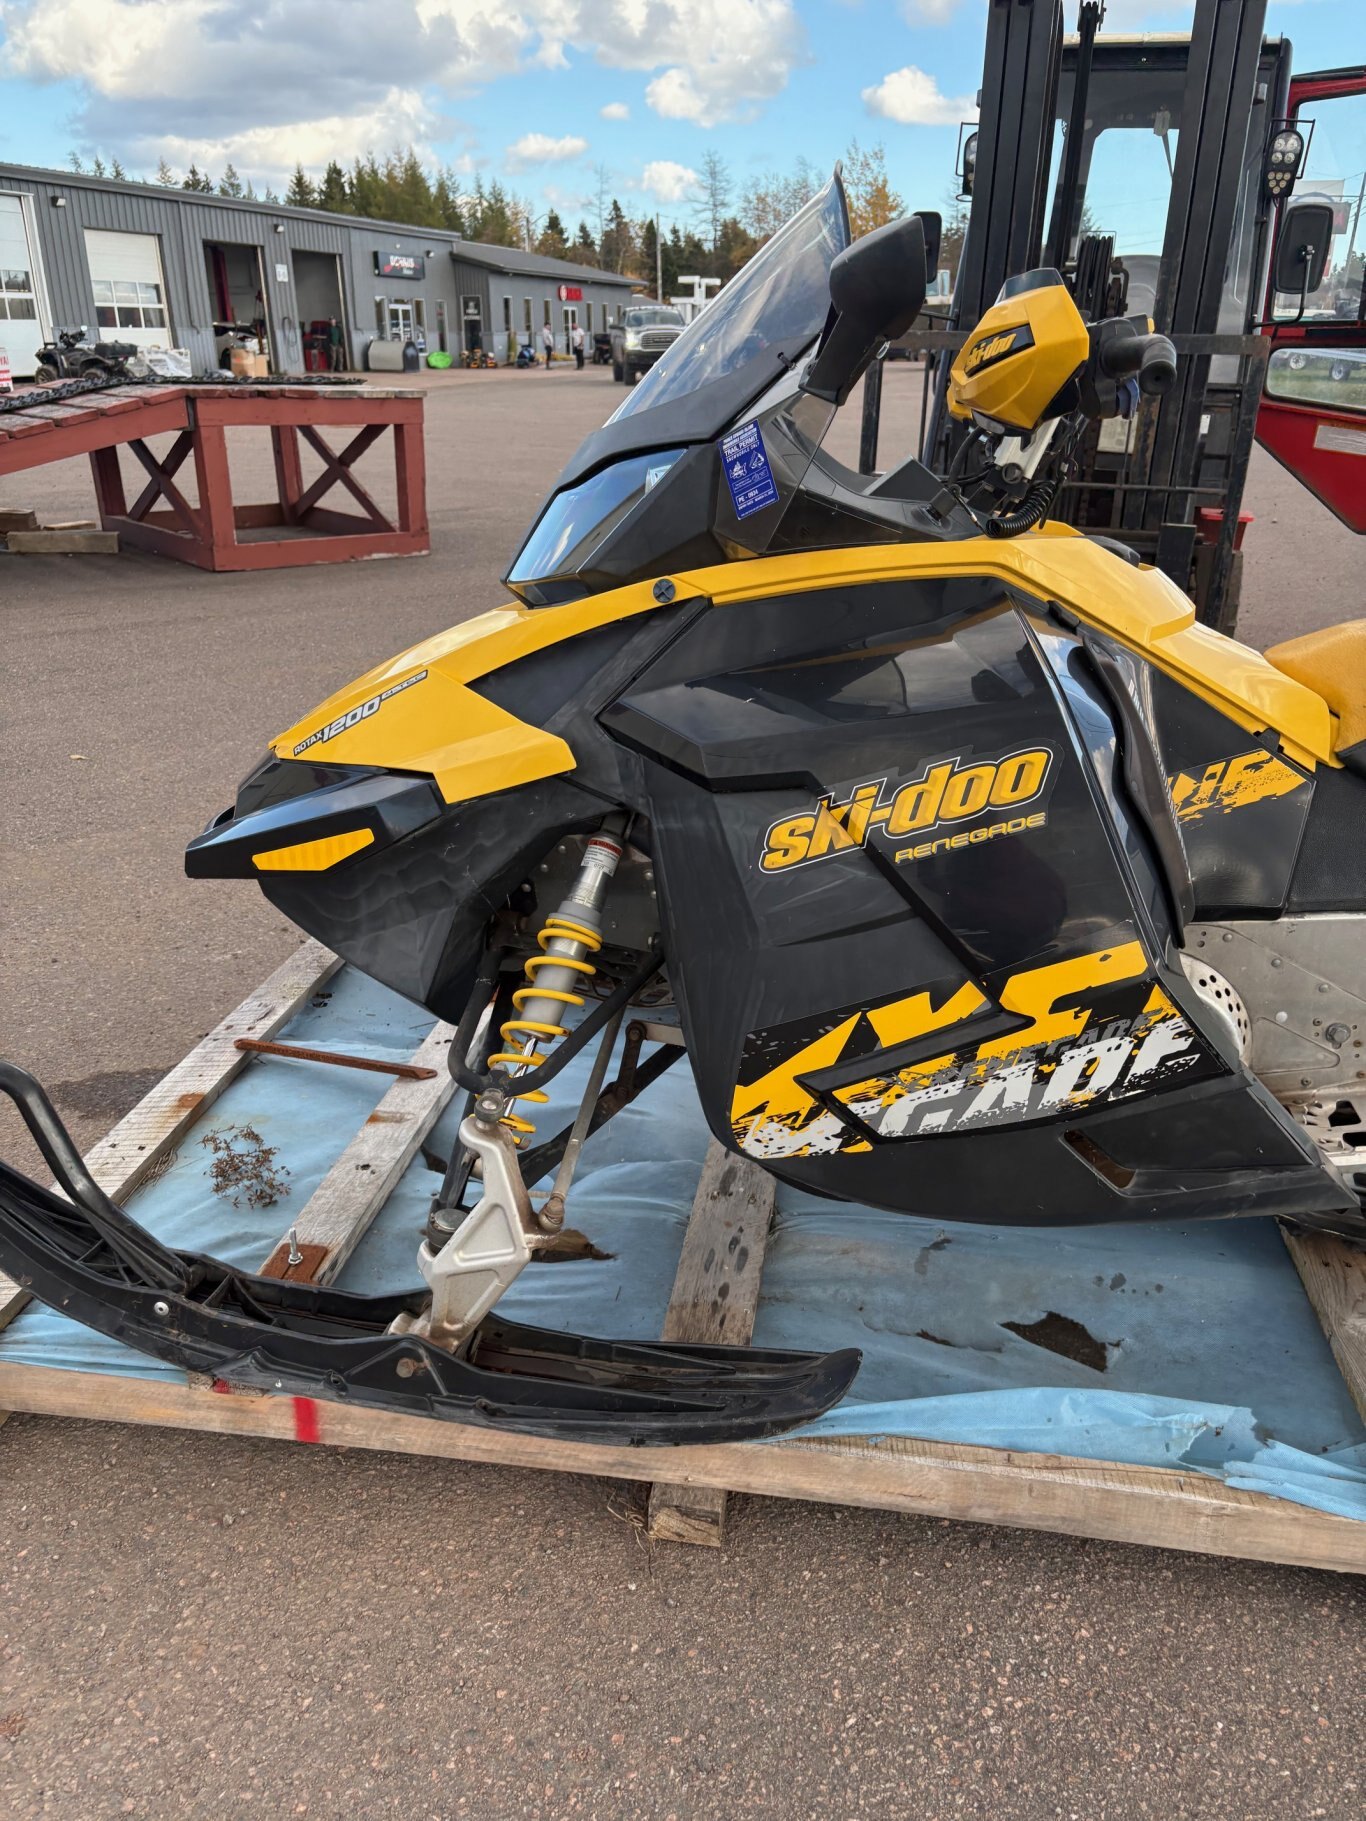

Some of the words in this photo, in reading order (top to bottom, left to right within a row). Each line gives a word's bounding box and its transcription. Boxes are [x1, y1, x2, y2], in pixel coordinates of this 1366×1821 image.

[739, 433, 758, 449] PERMIT
[294, 730, 322, 755] ROTAX
[321, 695, 381, 743] 1200
[762, 749, 1051, 870] ski-doo
[895, 812, 1047, 865] RENEGADE
